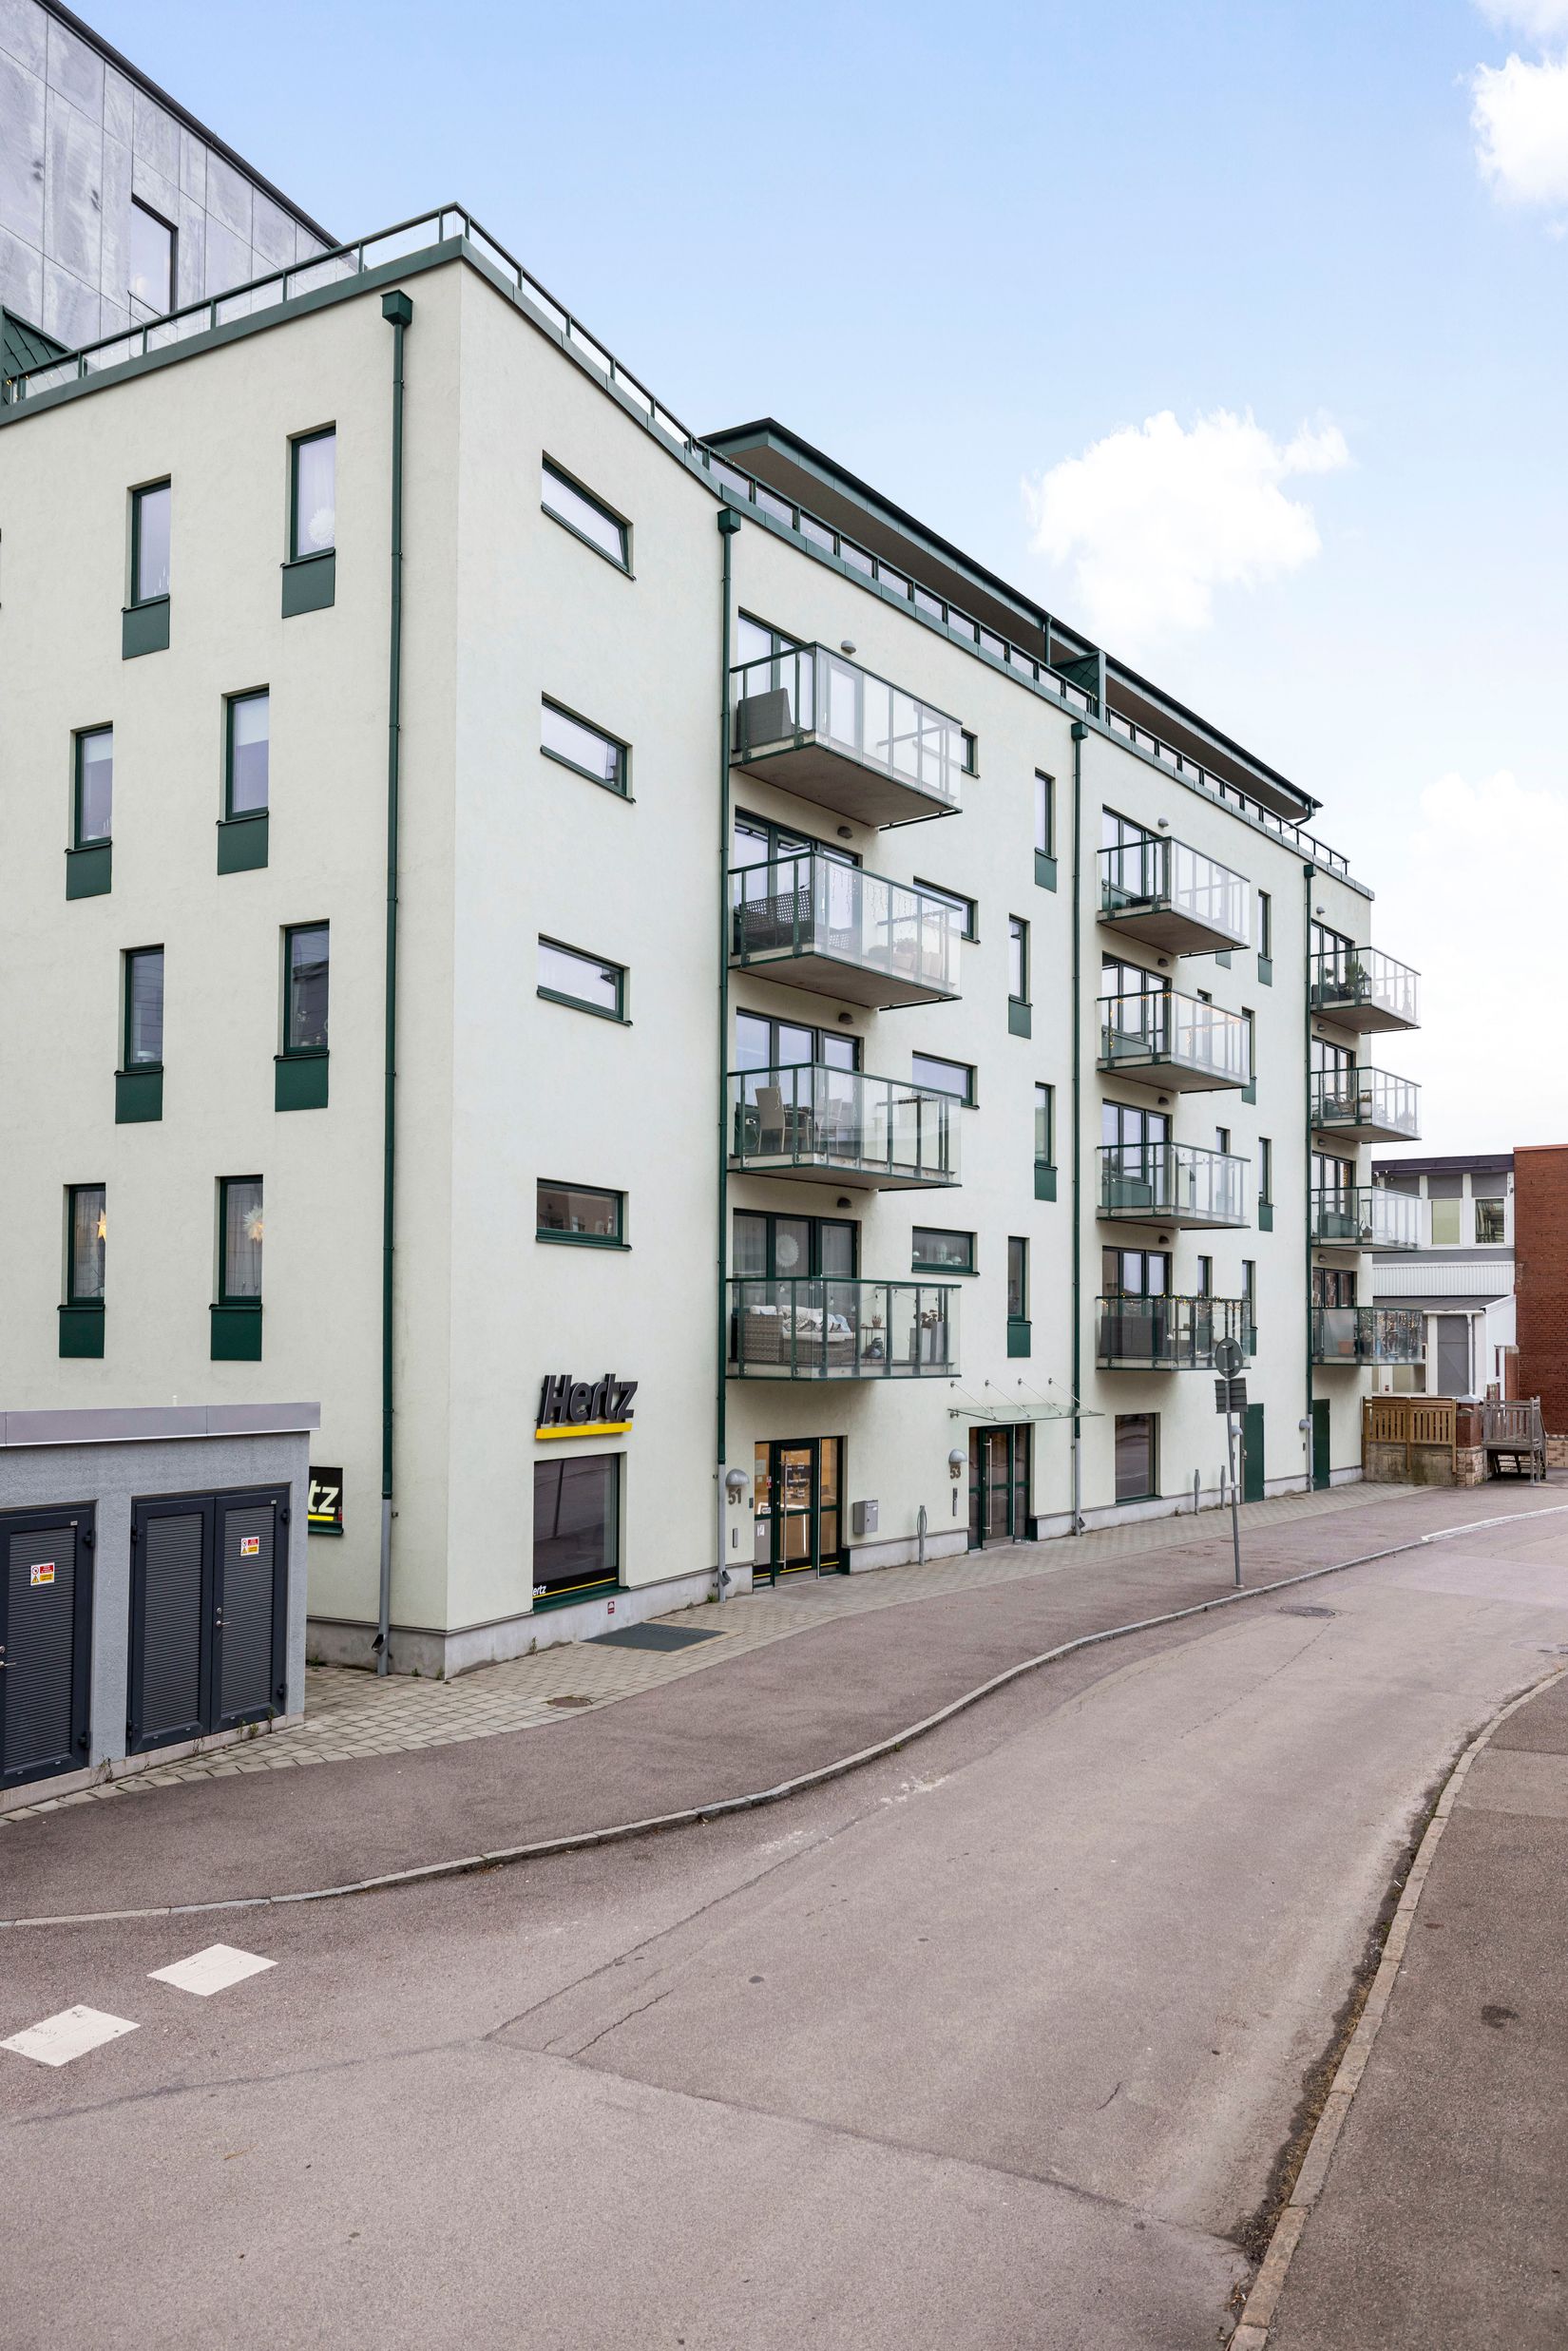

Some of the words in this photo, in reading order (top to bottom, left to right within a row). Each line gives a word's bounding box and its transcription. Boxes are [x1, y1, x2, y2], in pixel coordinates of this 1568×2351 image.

[538, 1373, 638, 1427] Hertz
[950, 1464, 961, 1480] 53
[728, 1487, 741, 1504] 51
[532, 1584, 546, 1596] ertz
